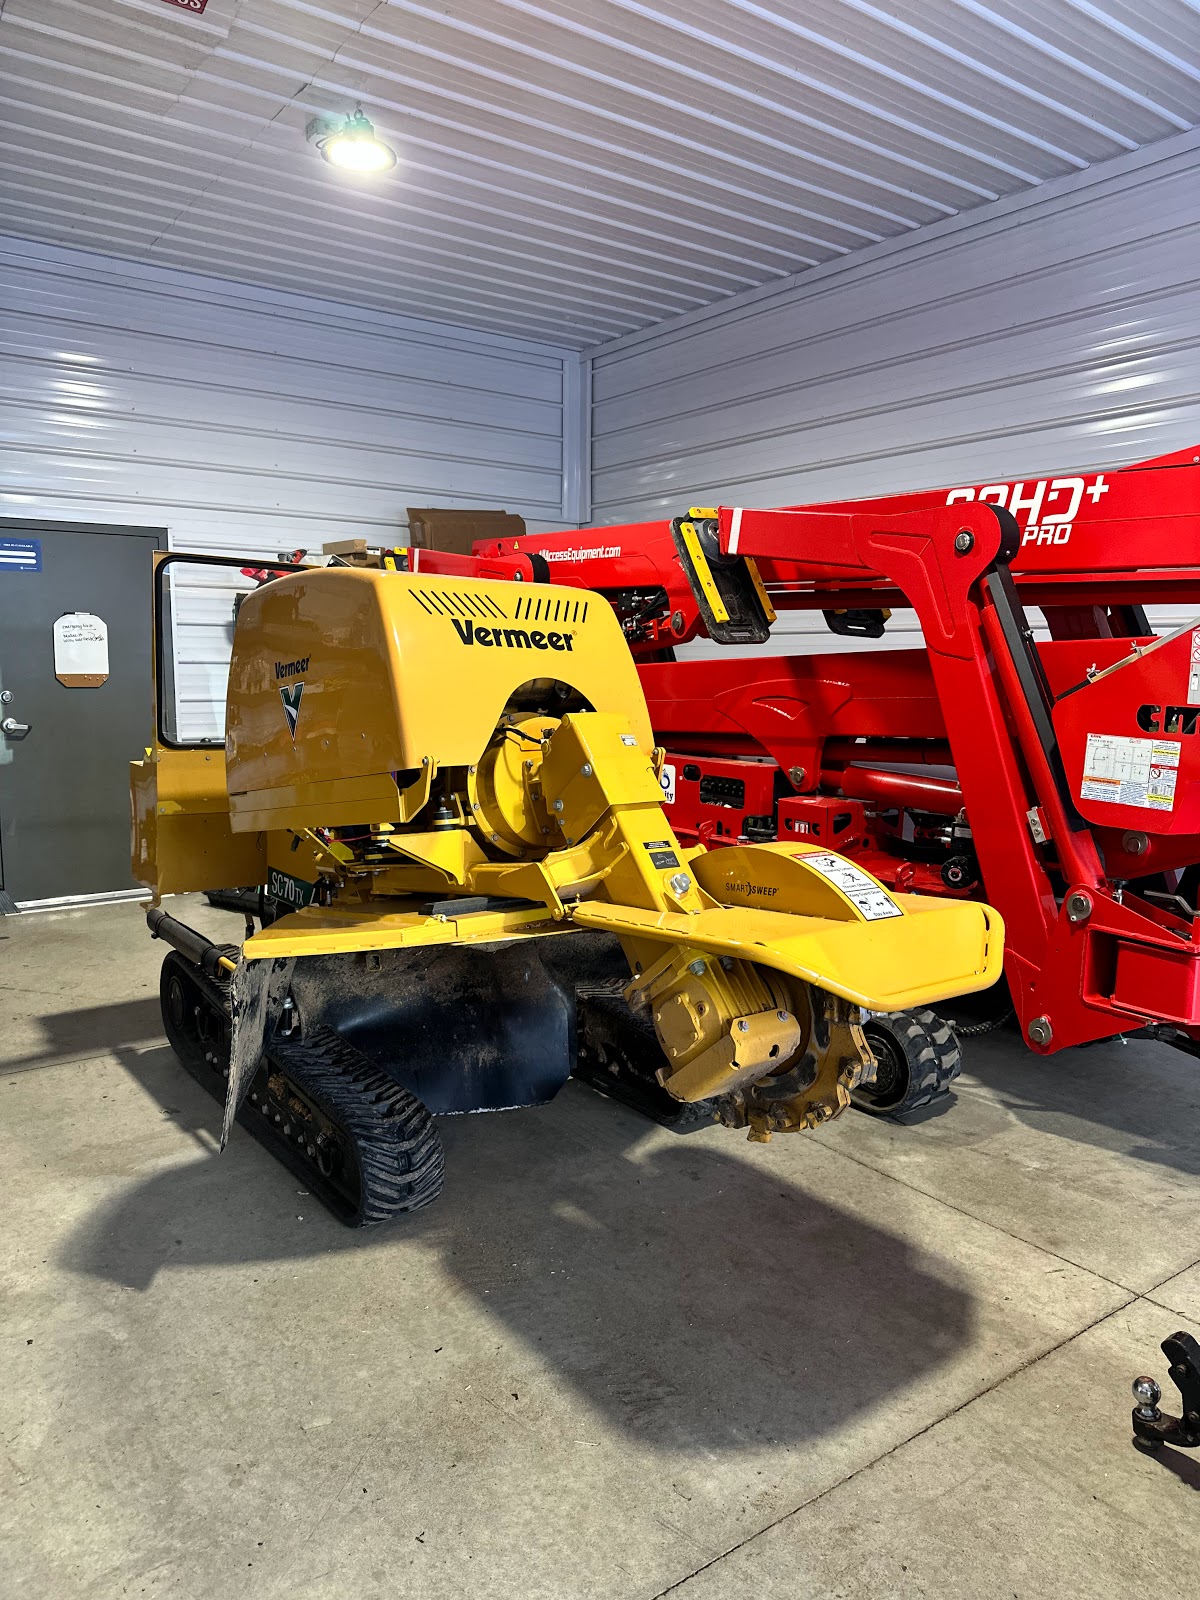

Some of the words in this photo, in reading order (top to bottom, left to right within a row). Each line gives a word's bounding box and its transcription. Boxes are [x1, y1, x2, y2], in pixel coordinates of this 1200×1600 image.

[1021, 524, 1072, 546] PRO
[451, 618, 574, 651] Vermeer
[275, 657, 309, 679] Vermeer
[664, 790, 674, 802] ity
